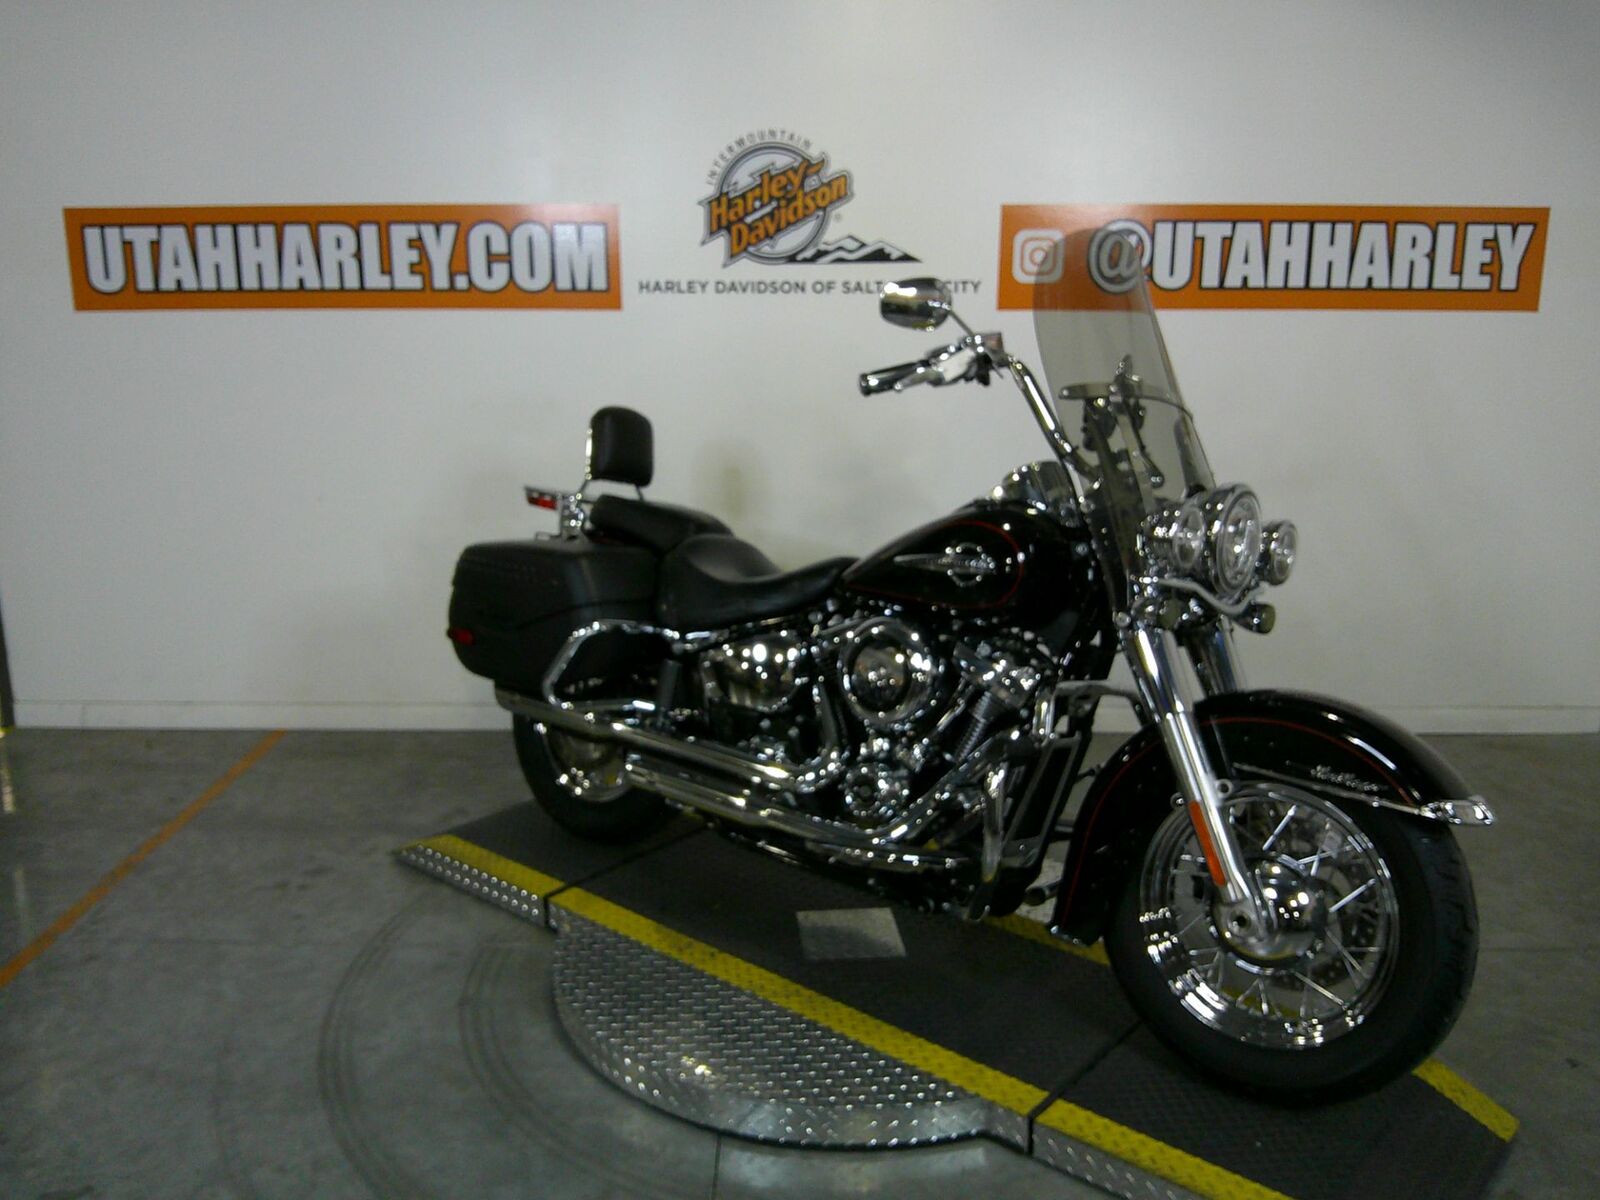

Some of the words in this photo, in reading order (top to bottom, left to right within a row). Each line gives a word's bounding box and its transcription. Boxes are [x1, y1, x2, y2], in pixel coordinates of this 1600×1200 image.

[705, 128, 812, 186] INTERMOUNTAIN
[730, 174, 849, 258] Davidson
[81, 221, 610, 294] UTAHHARLEY.COM
[638, 280, 709, 295] HARLEY
[714, 280, 807, 295] DAVIDSON
[811, 280, 836, 295] OF
[841, 280, 883, 295] SALT
[1087, 218, 1537, 294] @UTAHHARLEY
